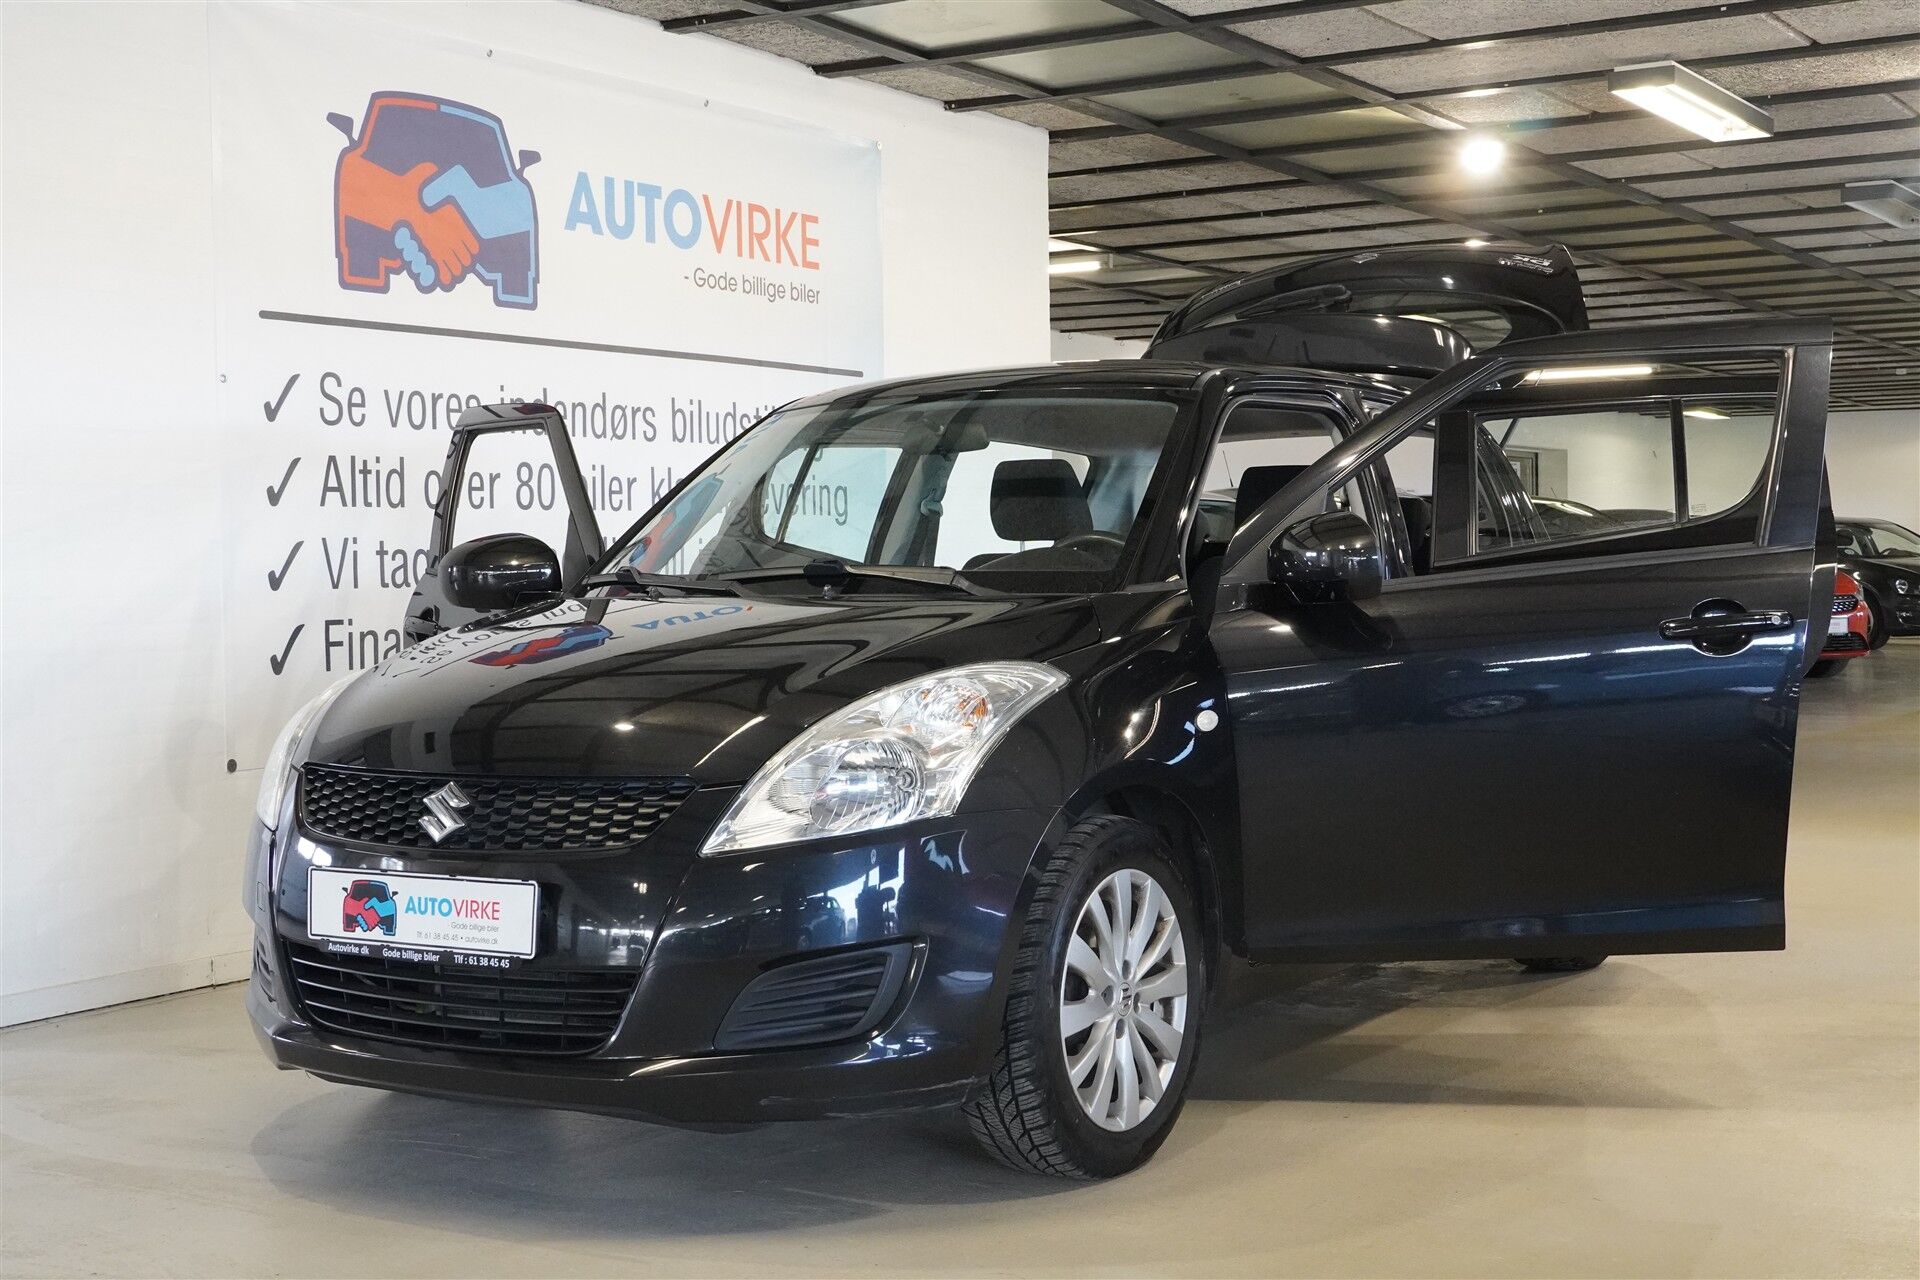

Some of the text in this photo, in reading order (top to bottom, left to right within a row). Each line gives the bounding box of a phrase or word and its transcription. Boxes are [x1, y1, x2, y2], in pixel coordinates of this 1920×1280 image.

[564, 170, 820, 271] AUTOVIRKE
[693, 267, 738, 292] Gode
[742, 274, 786, 304] billige
[790, 281, 821, 304] biler
[319, 371, 367, 427] Se
[320, 455, 406, 509] Altid
[424, 469, 501, 510] oer
[515, 461, 556, 511] 80
[583, 464, 638, 512] iler
[321, 537, 360, 590] Vi
[404, 895, 500, 921] AUTOVIRKE
[382, 948, 401, 959] Gode
[402, 950, 423, 962] billige
[424, 952, 440, 962] biler
[469, 956, 478, 965] 61
[480, 957, 489, 966] 38
[490, 958, 499, 967] 45
[500, 959, 510, 968] 45
